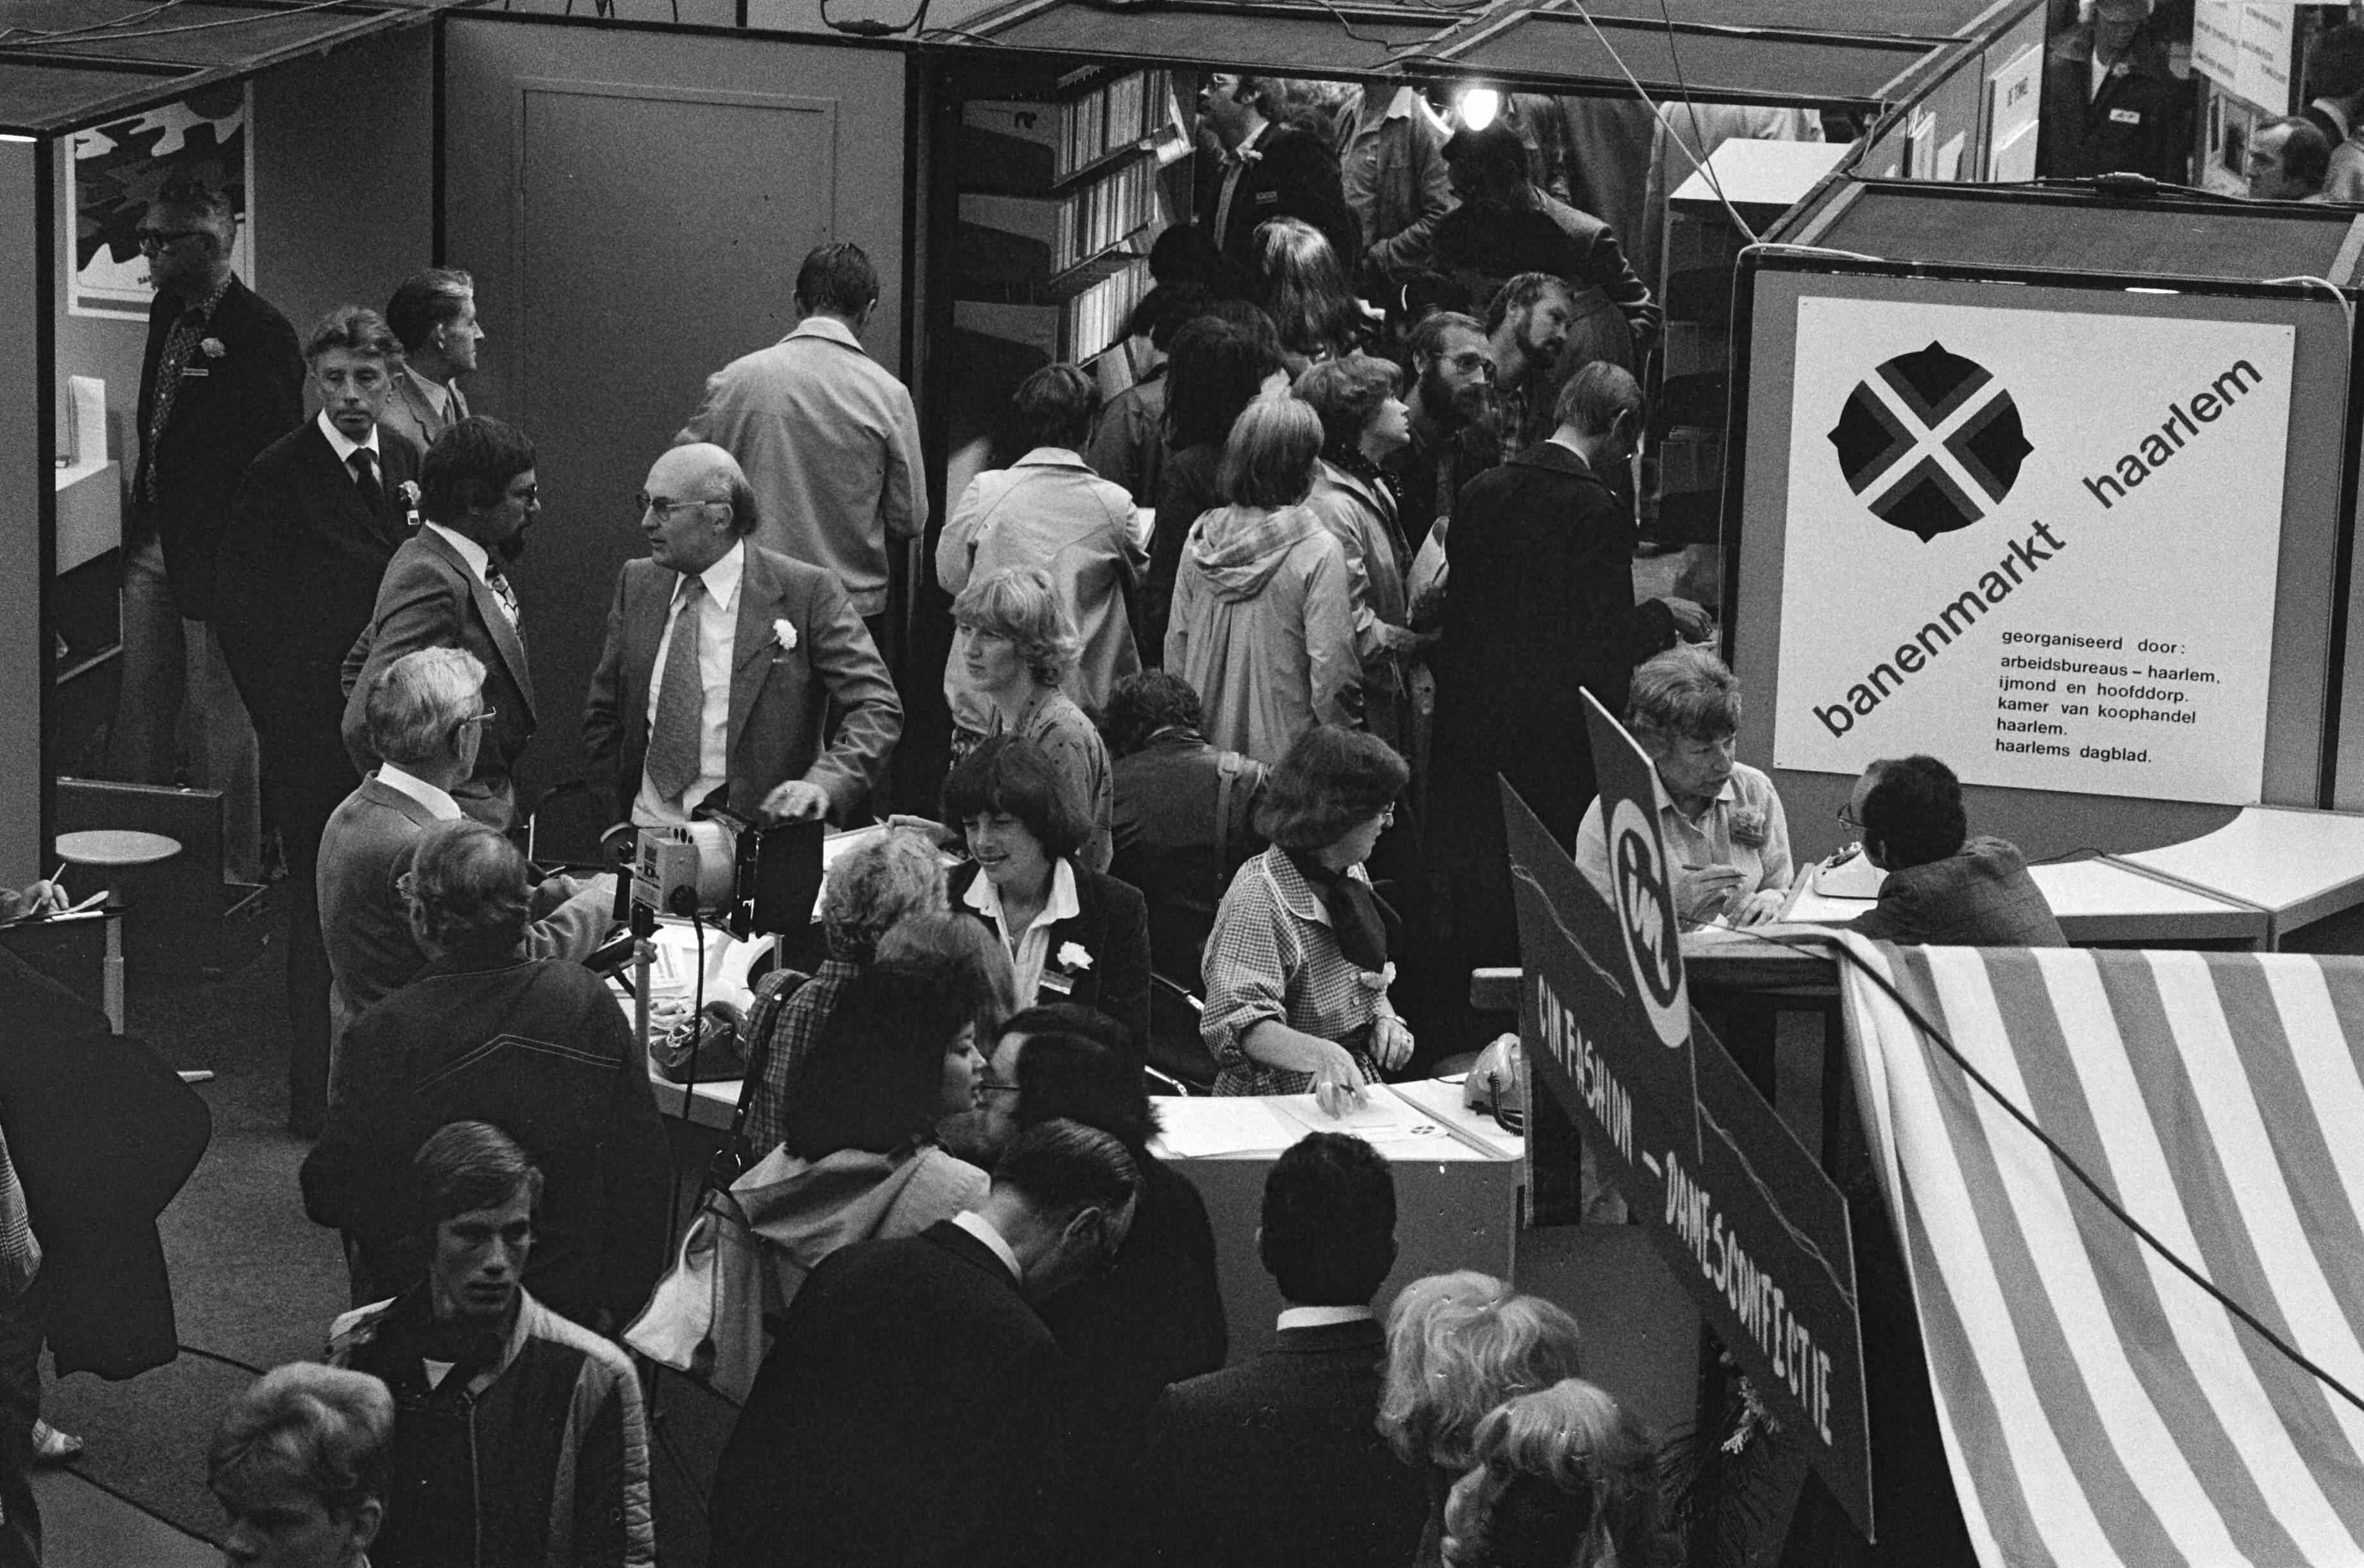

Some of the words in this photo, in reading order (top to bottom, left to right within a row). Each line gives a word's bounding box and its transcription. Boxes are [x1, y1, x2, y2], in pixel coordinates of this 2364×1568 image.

[1812, 520, 2067, 738] banenmarkt
[2082, 360, 2263, 509] haarlem
[2001, 631, 2123, 650] georganiseerd
[2001, 655, 2128, 676] arbeidsbureaus
[1999, 676, 2056, 692] ijmond
[2066, 683, 2086, 695] en
[2097, 683, 2188, 704] hoofddorp.
[1998, 696, 2049, 713] kamer
[2061, 704, 2089, 716] van
[2098, 704, 2196, 724] koophandel
[1997, 717, 2067, 735] haarlem.
[1995, 738, 2070, 757] haarlems
[2080, 745, 2151, 763] dagblad.
[1564, 1008, 1632, 1165] FASHION
[1665, 1150, 1832, 1446] DAMESCONFECTIE
